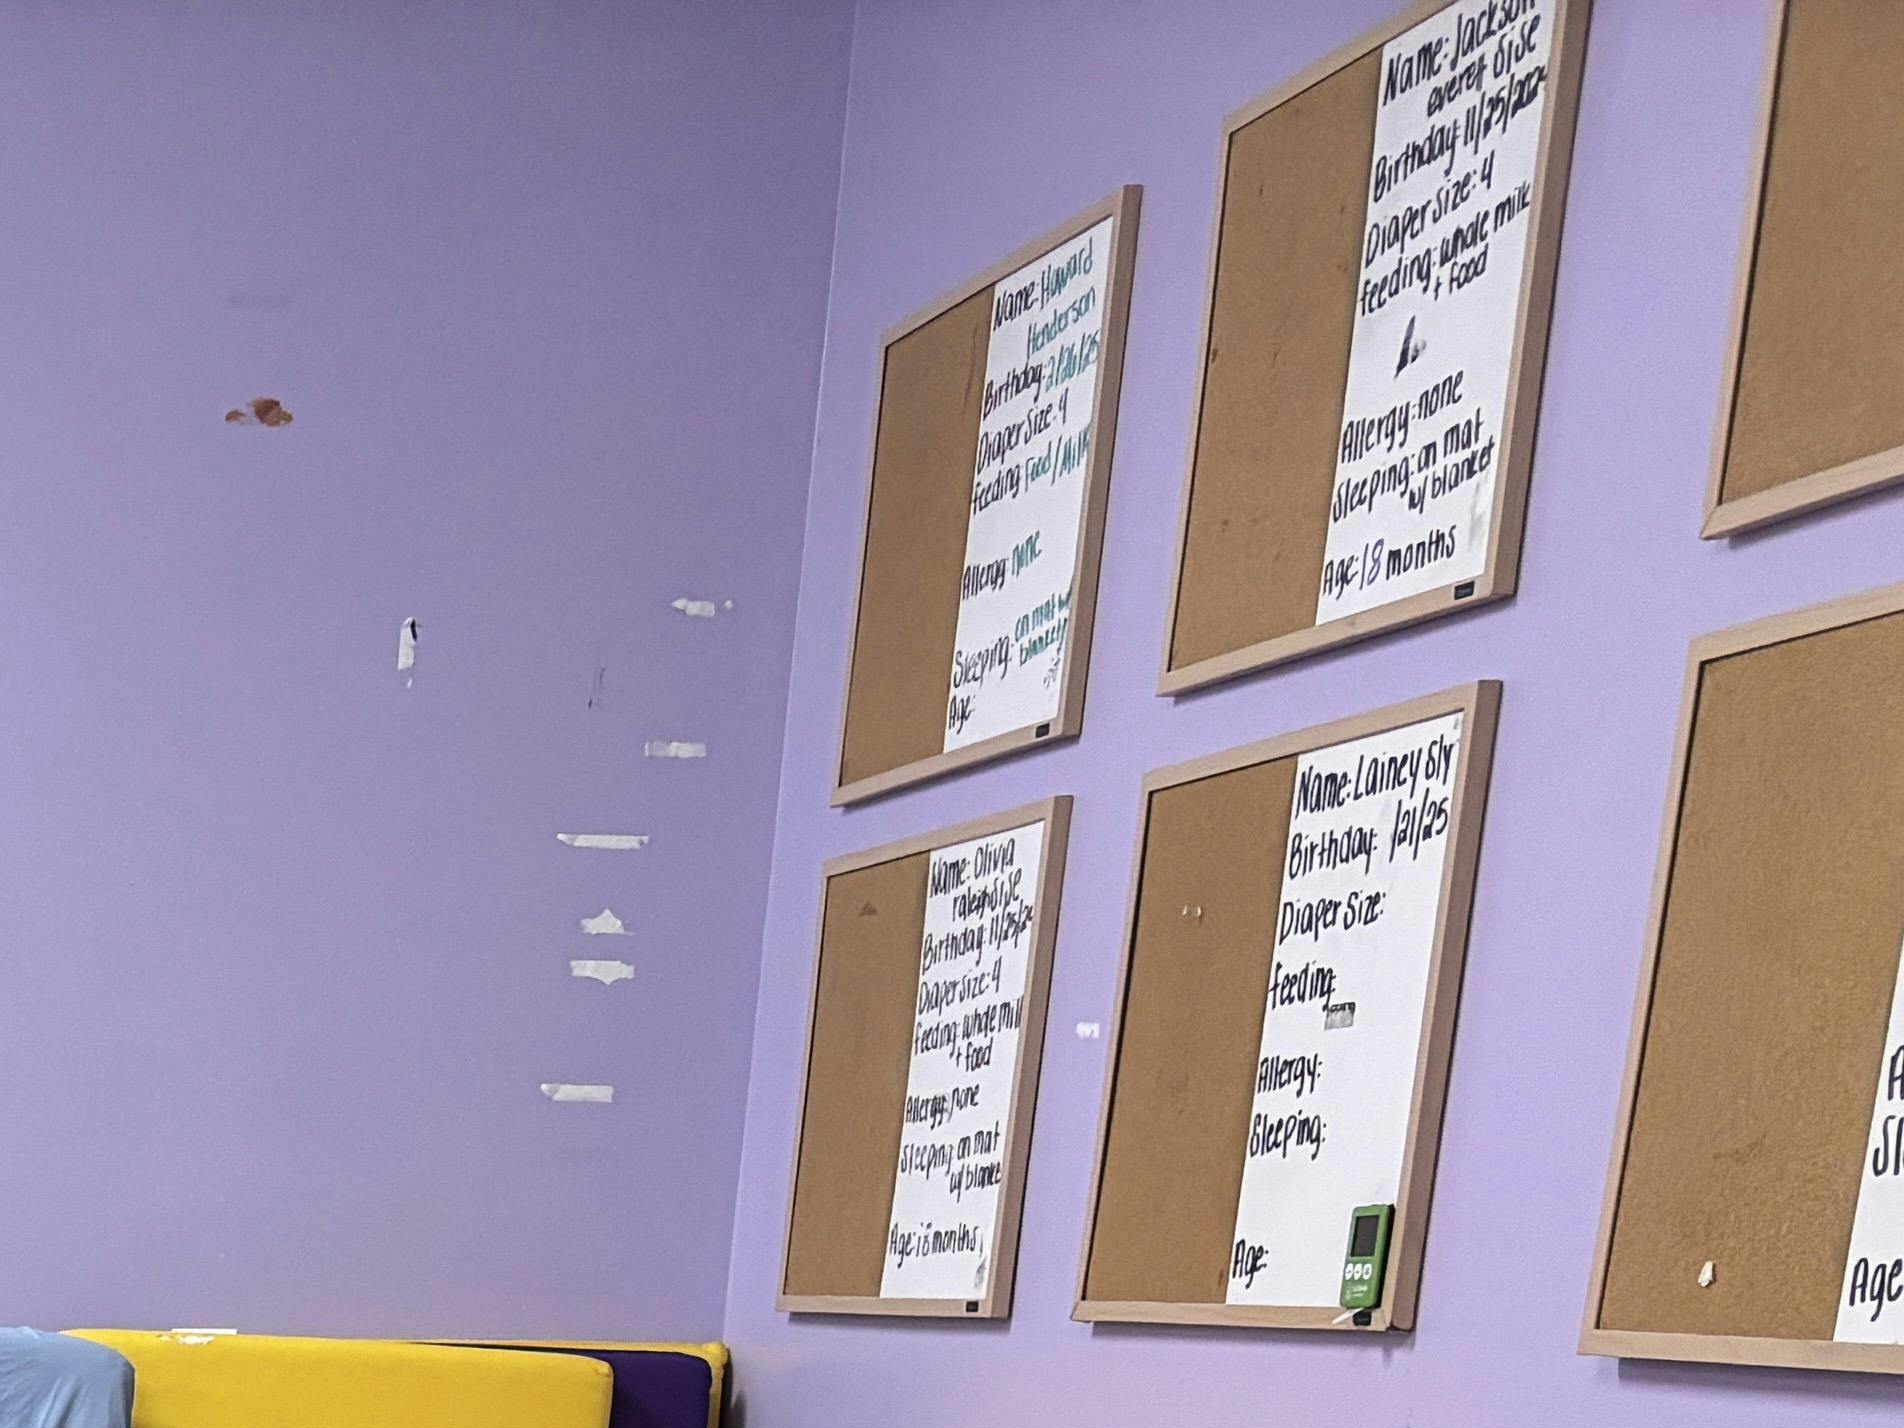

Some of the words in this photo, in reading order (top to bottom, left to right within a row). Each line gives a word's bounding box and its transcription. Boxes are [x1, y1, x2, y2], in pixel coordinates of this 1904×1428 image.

[1366, 199, 1431, 269] Diaper
[1481, 149, 1494, 190] 4
[1418, 370, 1464, 420] none
[1417, 440, 1437, 475] on
[1443, 407, 1484, 459] mat
[1430, 435, 1495, 500] blanket
[1323, 555, 1360, 600] Age:
[1359, 538, 1384, 590] 18
[1385, 525, 1456, 580] months
[1295, 765, 1352, 820] Name:
[1353, 747, 1423, 799] Lainey
[1288, 825, 1377, 880] Birthday:
[1279, 898, 1342, 946] Diaper
[1343, 890, 1386, 931] Size:
[992, 956, 1003, 993] 4
[1257, 1053, 1322, 1098] Allergy:
[1249, 1109, 1327, 1161] Sleeping:
[1232, 1239, 1269, 1290] Age:
